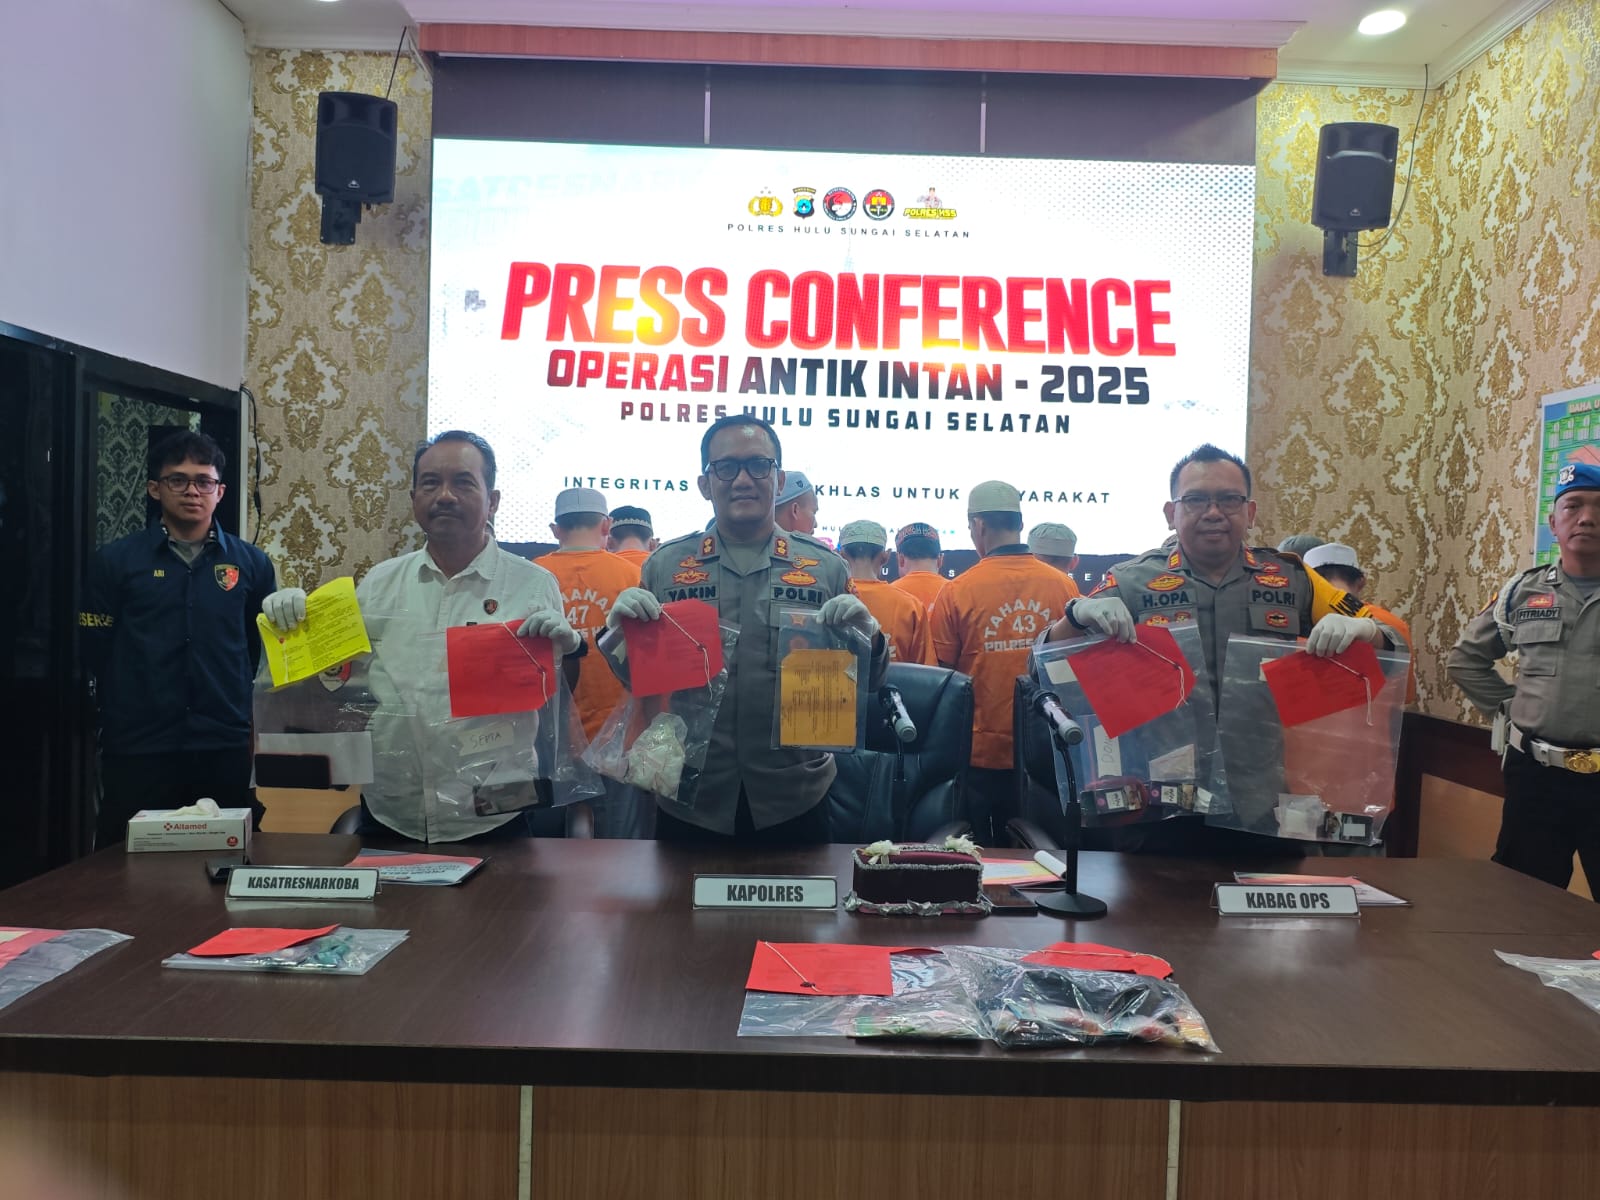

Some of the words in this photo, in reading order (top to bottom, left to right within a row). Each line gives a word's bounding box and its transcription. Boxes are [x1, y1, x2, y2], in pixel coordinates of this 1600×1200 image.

[727, 223, 785, 233] POLRES
[793, 226, 832, 235] HULU
[840, 228, 896, 237] SUNGAI
[905, 229, 970, 238] SELATAN
[501, 261, 728, 347] PRESS
[744, 269, 1177, 357] CONFERENCE
[547, 349, 728, 393] OPERASI
[738, 356, 869, 398] ANTIK
[878, 360, 1003, 402] INTAN
[1040, 364, 1150, 405] 2025
[621, 401, 727, 424] POLRES
[827, 408, 932, 430] SUNGAI
[947, 412, 1070, 433] SELATAN
[564, 476, 689, 491] INTEGRITAS
[815, 484, 881, 498] KHLAS
[893, 487, 960, 500] UNTUK
[668, 585, 716, 602] YAKIN
[774, 586, 823, 604] POLRI
[1142, 590, 1190, 608] H.OPA
[1251, 589, 1295, 606] POLRI
[567, 605, 590, 625] 47
[1519, 608, 1558, 618] FITRIADY
[1012, 614, 1037, 634] 43
[247, 875, 360, 891] KASATRESNARKOBA
[727, 885, 804, 902] KAPOLRES
[1245, 892, 1296, 909] KABAG
[1299, 893, 1331, 909] OPS
